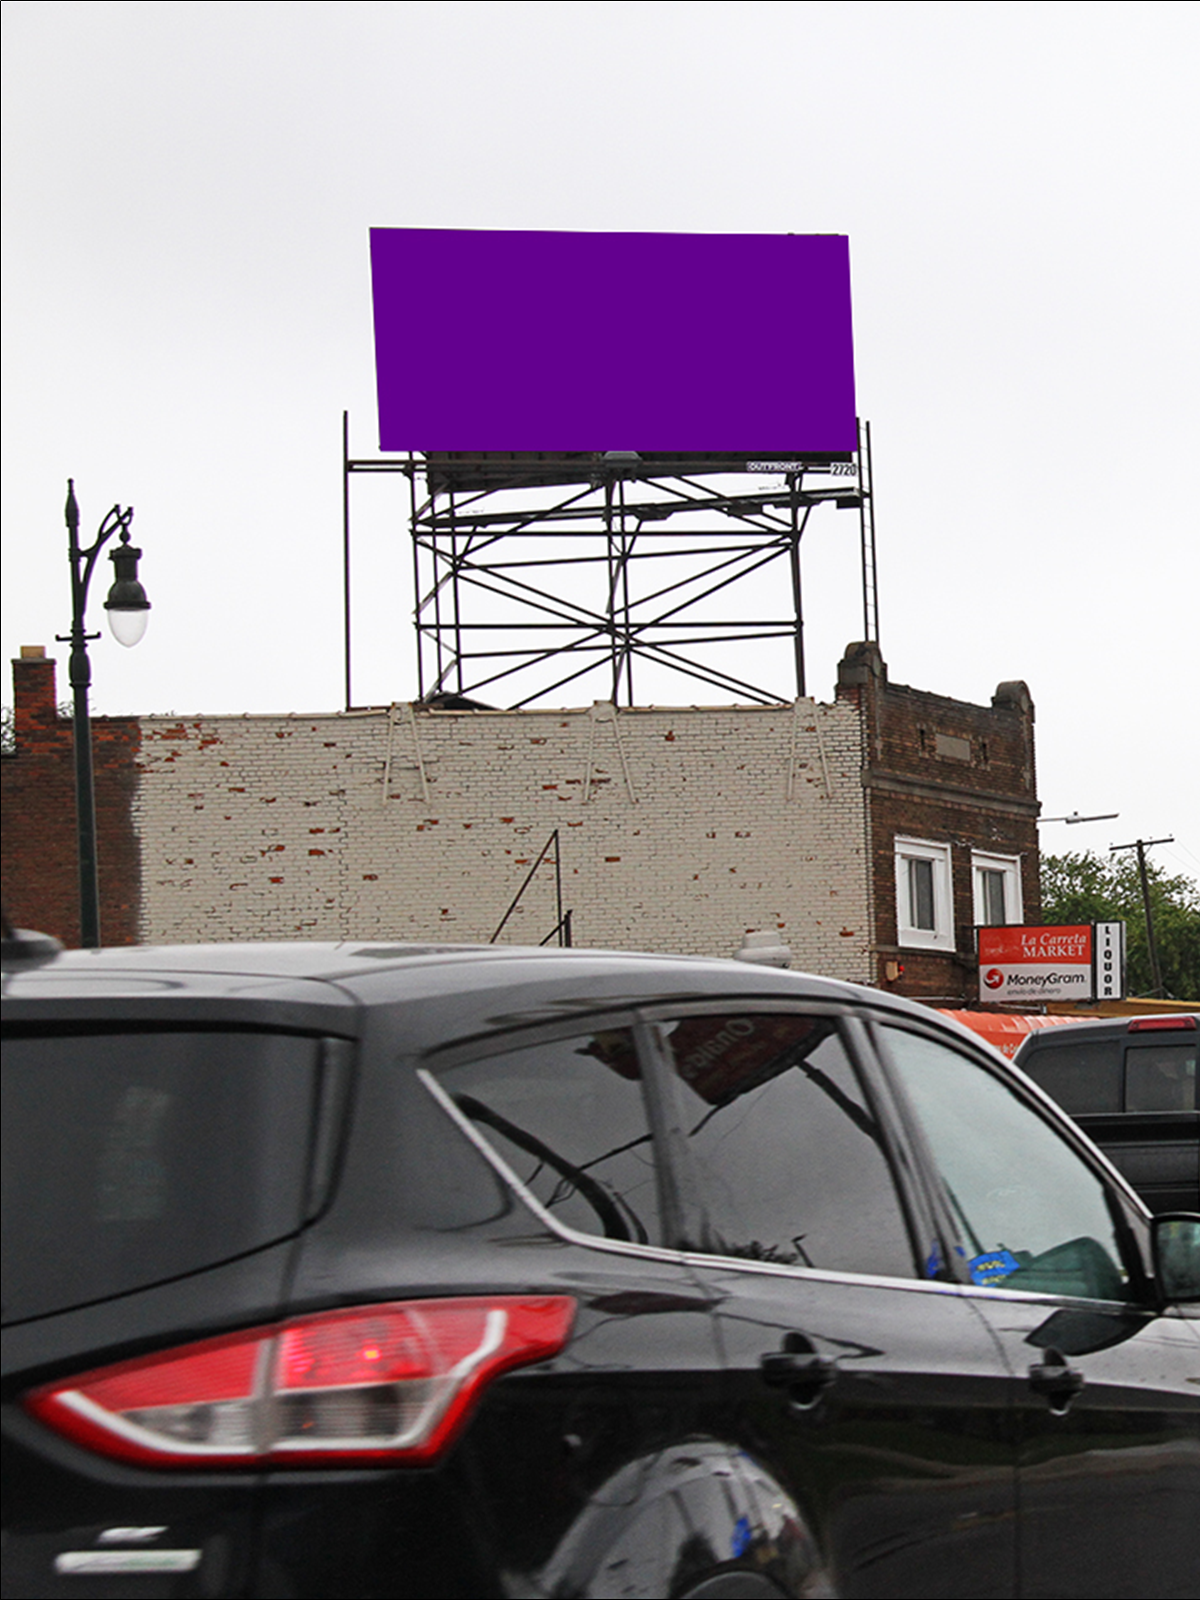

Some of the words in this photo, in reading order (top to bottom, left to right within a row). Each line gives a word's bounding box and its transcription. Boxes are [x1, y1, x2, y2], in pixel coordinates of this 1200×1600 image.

[831, 463, 857, 476] 2720
[1021, 934, 1037, 946] La
[1040, 932, 1087, 946] Carreta
[1022, 944, 1085, 958] MARKET
[1103, 925, 1113, 996] LIQUOR
[1007, 972, 1085, 988] MoneyGram
